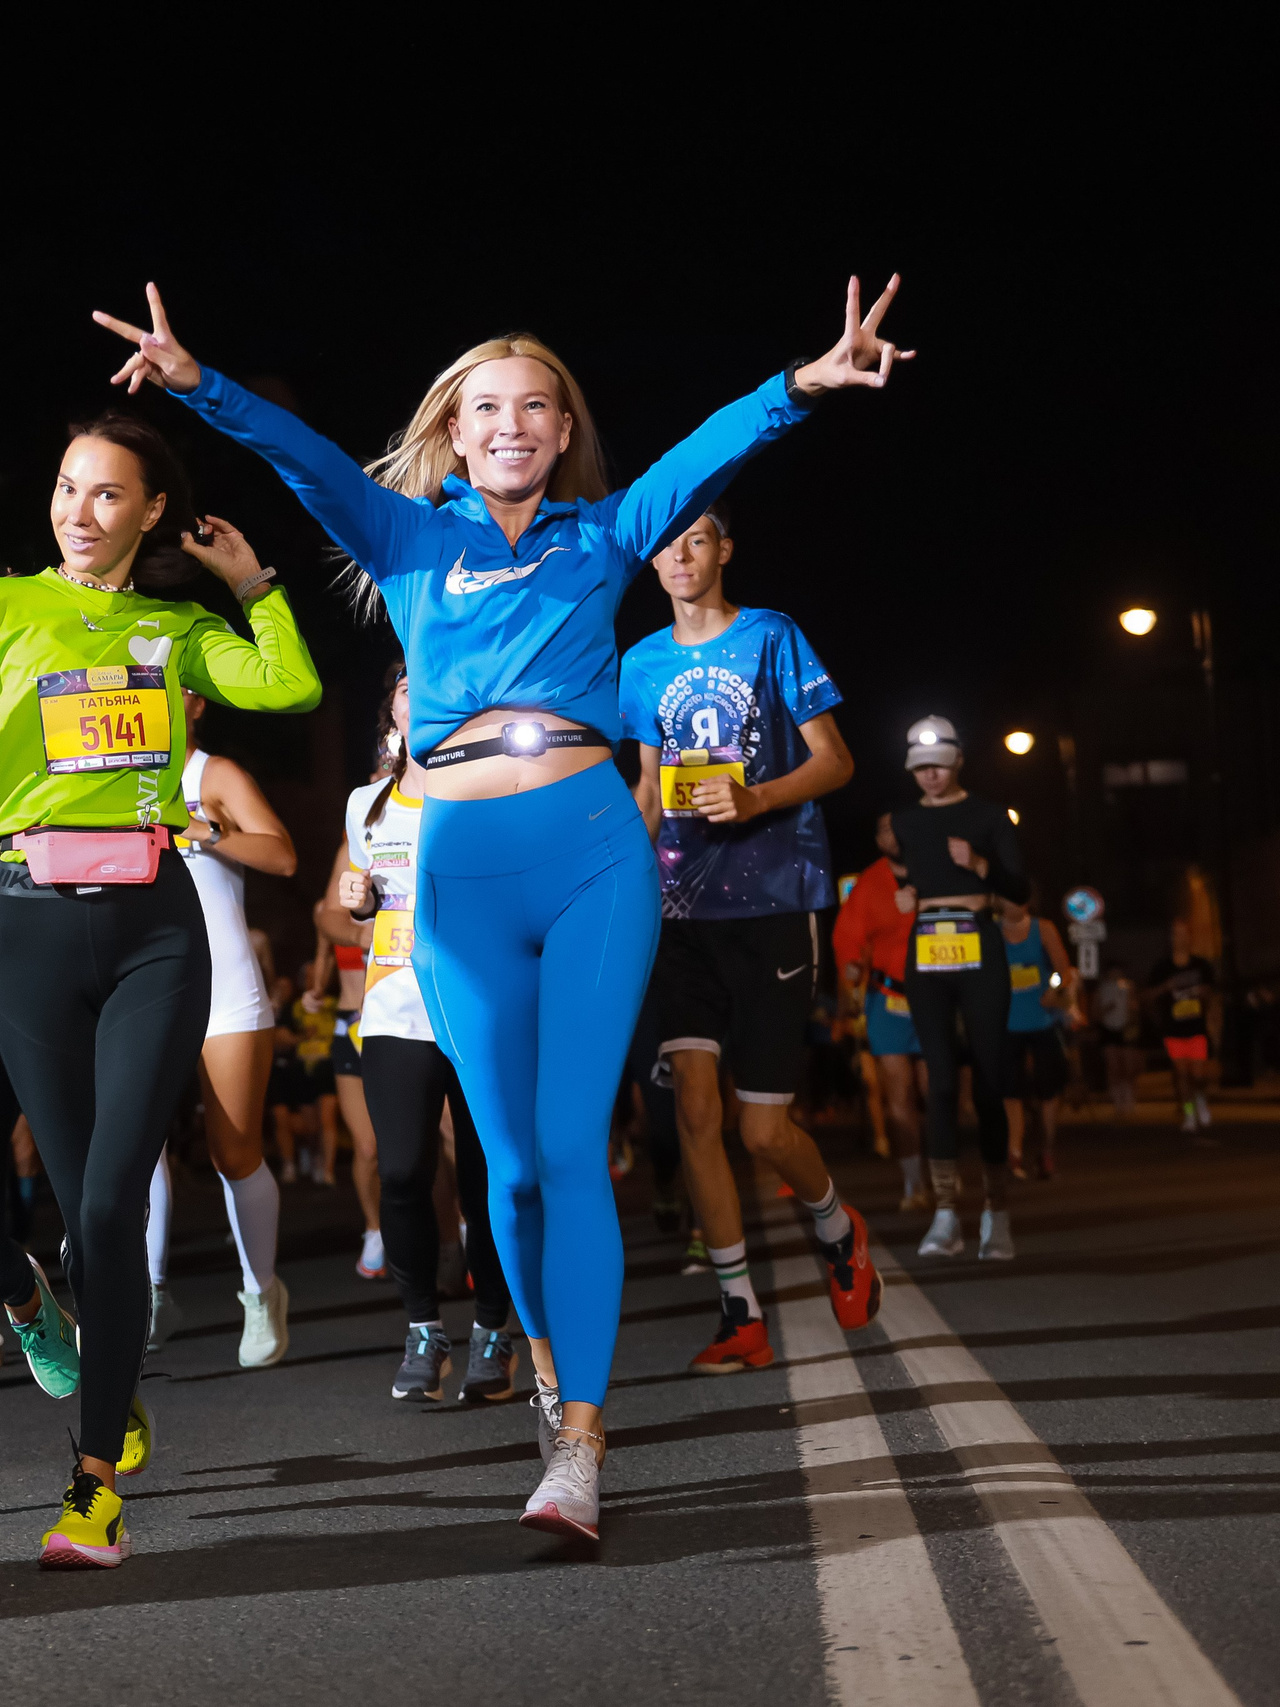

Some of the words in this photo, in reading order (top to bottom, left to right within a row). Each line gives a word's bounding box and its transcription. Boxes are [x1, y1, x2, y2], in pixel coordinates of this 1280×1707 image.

[78, 694, 141, 709] ТАТЬЯНА
[658, 666, 704, 717] ПРОСТО
[707, 665, 761, 718] КОСМОС
[79, 712, 146, 751] 5141
[546, 734, 583, 743] VENTURE
[691, 707, 720, 748] Я
[389, 928, 415, 953] 53
